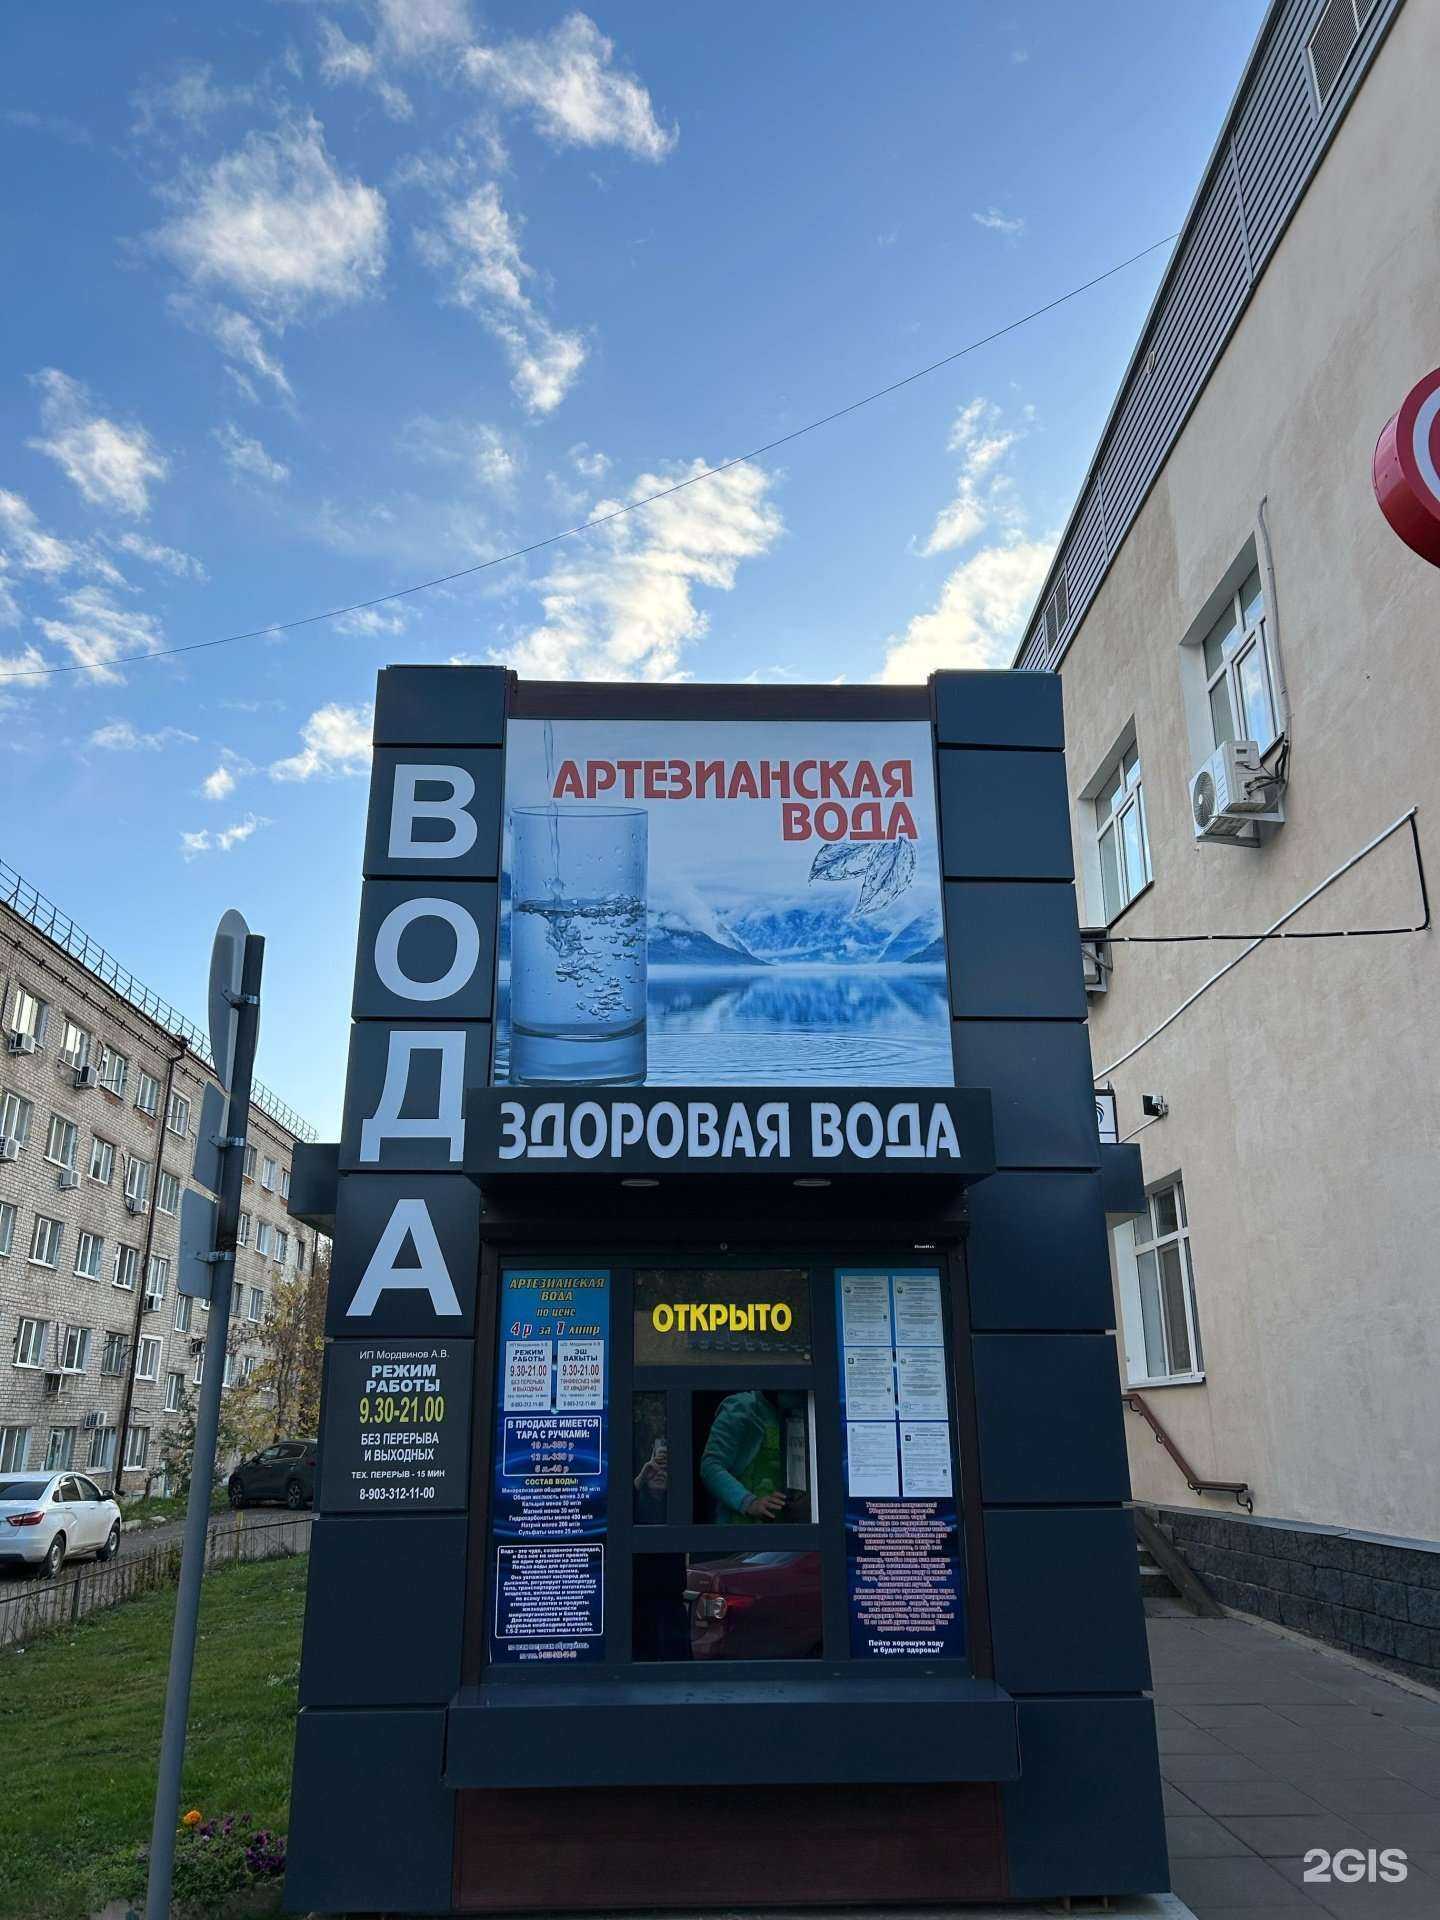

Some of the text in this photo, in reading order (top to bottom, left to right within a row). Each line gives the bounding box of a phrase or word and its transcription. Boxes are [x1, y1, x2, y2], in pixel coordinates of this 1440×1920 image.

[552, 760, 913, 799] АРТЕЗИАНСКАЯ
[782, 802, 918, 842] ВОДА
[344, 763, 480, 1317] ВОДА
[499, 1101, 961, 1160] ЗДОРОВАЯ ВОДА
[509, 1278, 605, 1289] АРТЕЗИАНСКАЯ
[541, 1291, 573, 1301] ВОДА
[536, 1308, 576, 1317] по цене
[652, 1303, 792, 1333] ОТКРЫТО
[510, 1321, 520, 1336] 4
[539, 1326, 551, 1335] за
[556, 1321, 565, 1336] 1
[359, 1349, 450, 1361] ИП Мордвинов А.В.
[371, 1364, 437, 1378] РЕЖИМ
[510, 1365, 548, 1377] 9.30-21.00
[562, 1364, 600, 1376] 9.30-21.00
[365, 1378, 441, 1393] РАБОТЫ
[359, 1395, 445, 1424] 9.30-21.00
[507, 1418, 599, 1430] В ПРОДАЖЕ ИМЕЕТСЯ
[360, 1431, 440, 1445] БЕЗ ПЕРЕРЫВА
[516, 1429, 590, 1440] ТАРА С РУЧКАМИ:
[364, 1448, 435, 1463] И ВЫХОДНЫХ
[351, 1471, 369, 1479] ТЕХ.
[370, 1470, 410, 1479] ПЕРЕРЫВ
[417, 1470, 426, 1478] 15
[427, 1469, 446, 1477] МИН
[525, 1478, 554, 1486] СОСТАВ
[359, 1487, 435, 1500] 8-903-312-11-00
[868, 1639, 945, 1648] Пейте хорошую воду
[879, 1646, 905, 1655] будете
